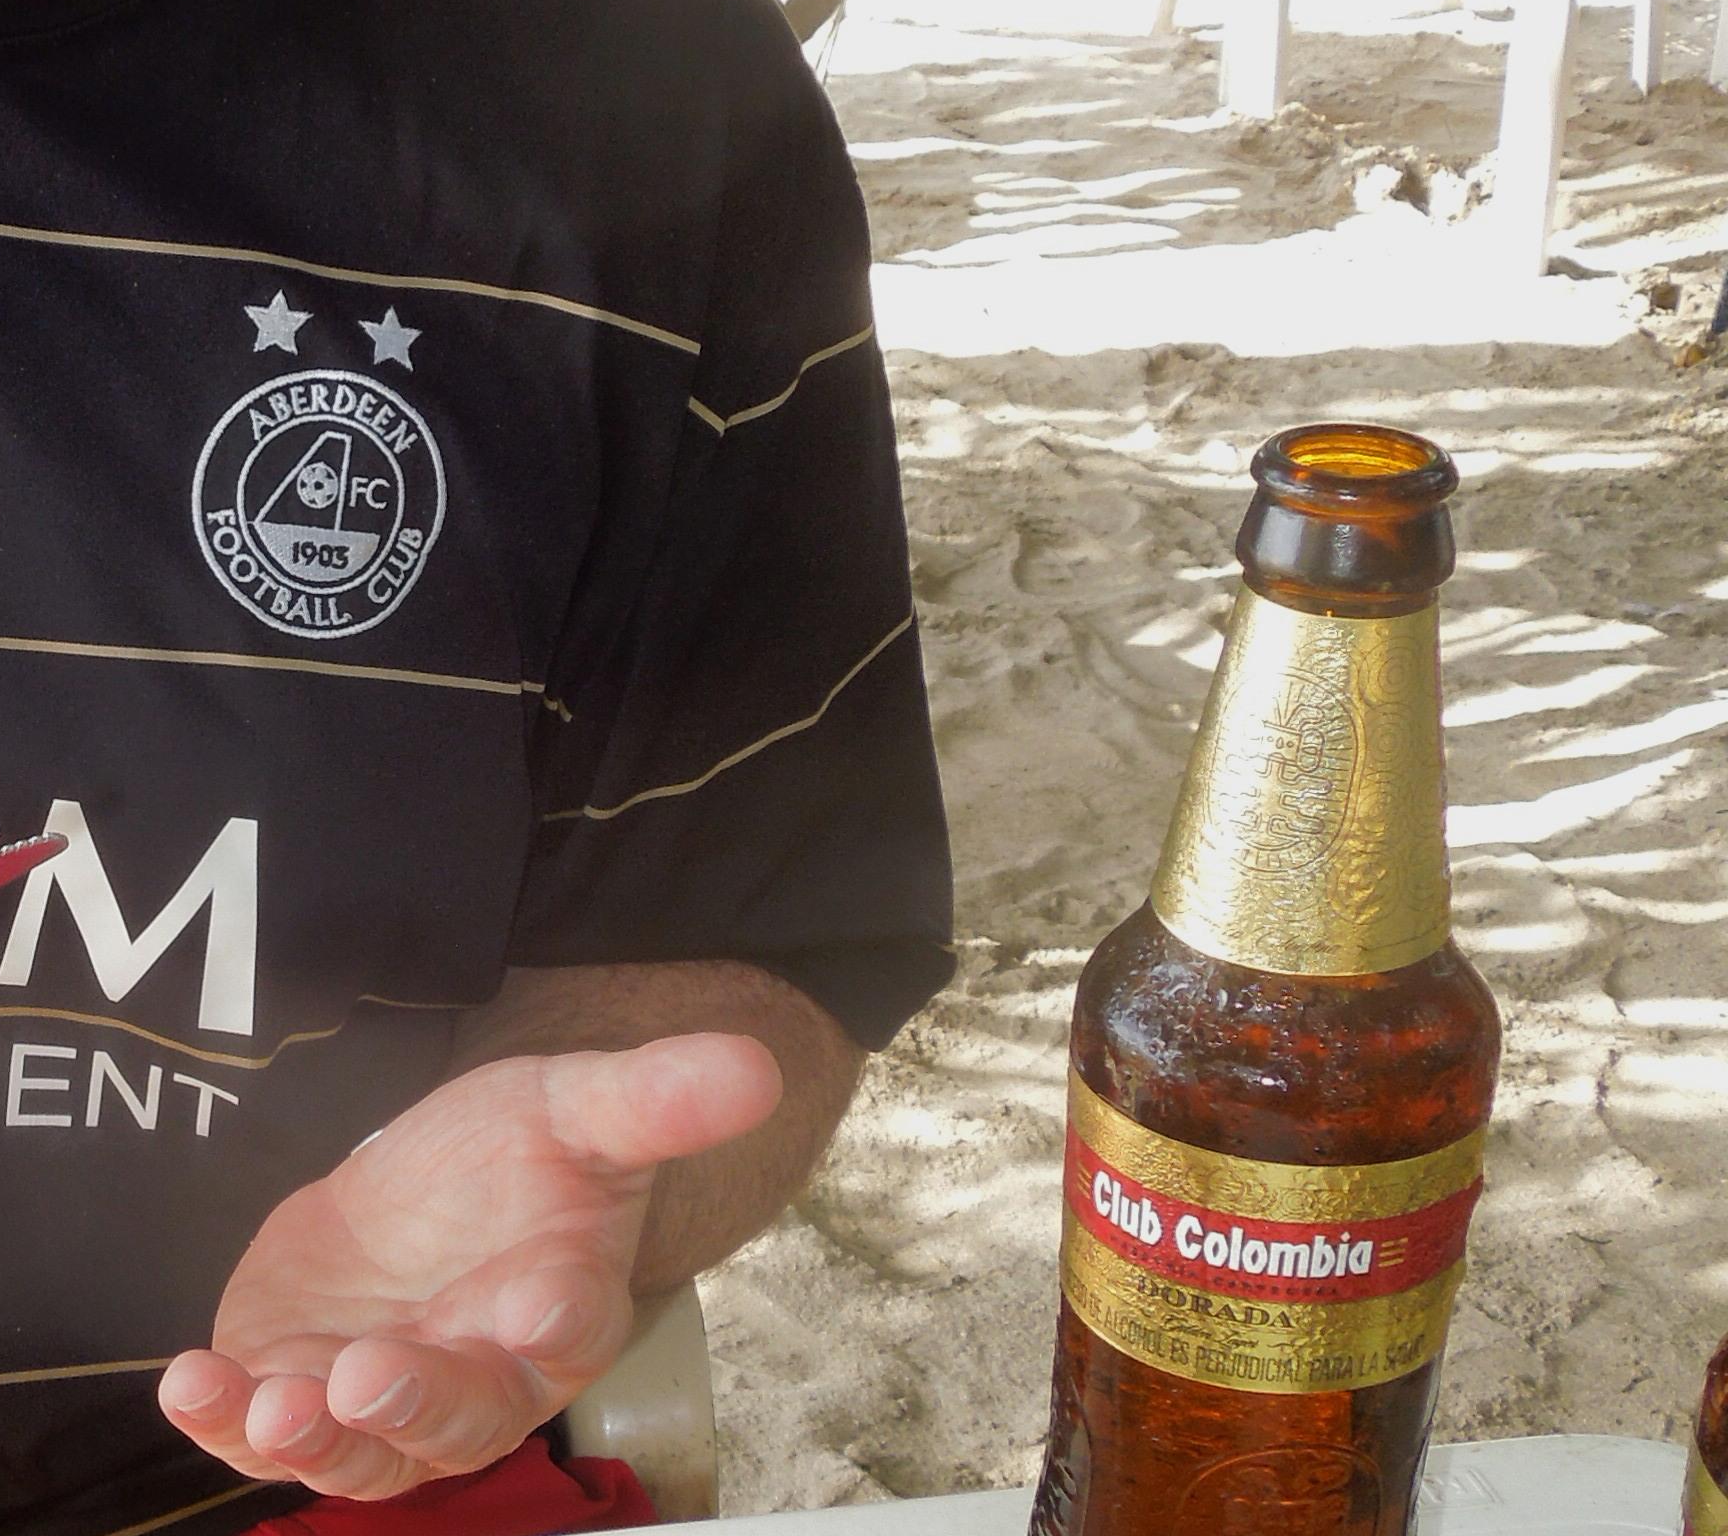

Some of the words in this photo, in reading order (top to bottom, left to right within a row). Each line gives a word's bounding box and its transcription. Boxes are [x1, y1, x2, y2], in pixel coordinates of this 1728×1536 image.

[247, 383, 419, 456] ABERDEEN
[349, 477, 390, 510] FC
[207, 508, 352, 627] FOOTBALL
[367, 527, 424, 604] CLUB
[1092, 1169, 1163, 1246] Club
[1175, 1214, 1373, 1279] Colombia
[1138, 1275, 1295, 1328] DORADA
[1170, 1337, 1189, 1366] ES
[1196, 1346, 1303, 1383] PERJUDICIAL
[1308, 1355, 1353, 1381] PARA
